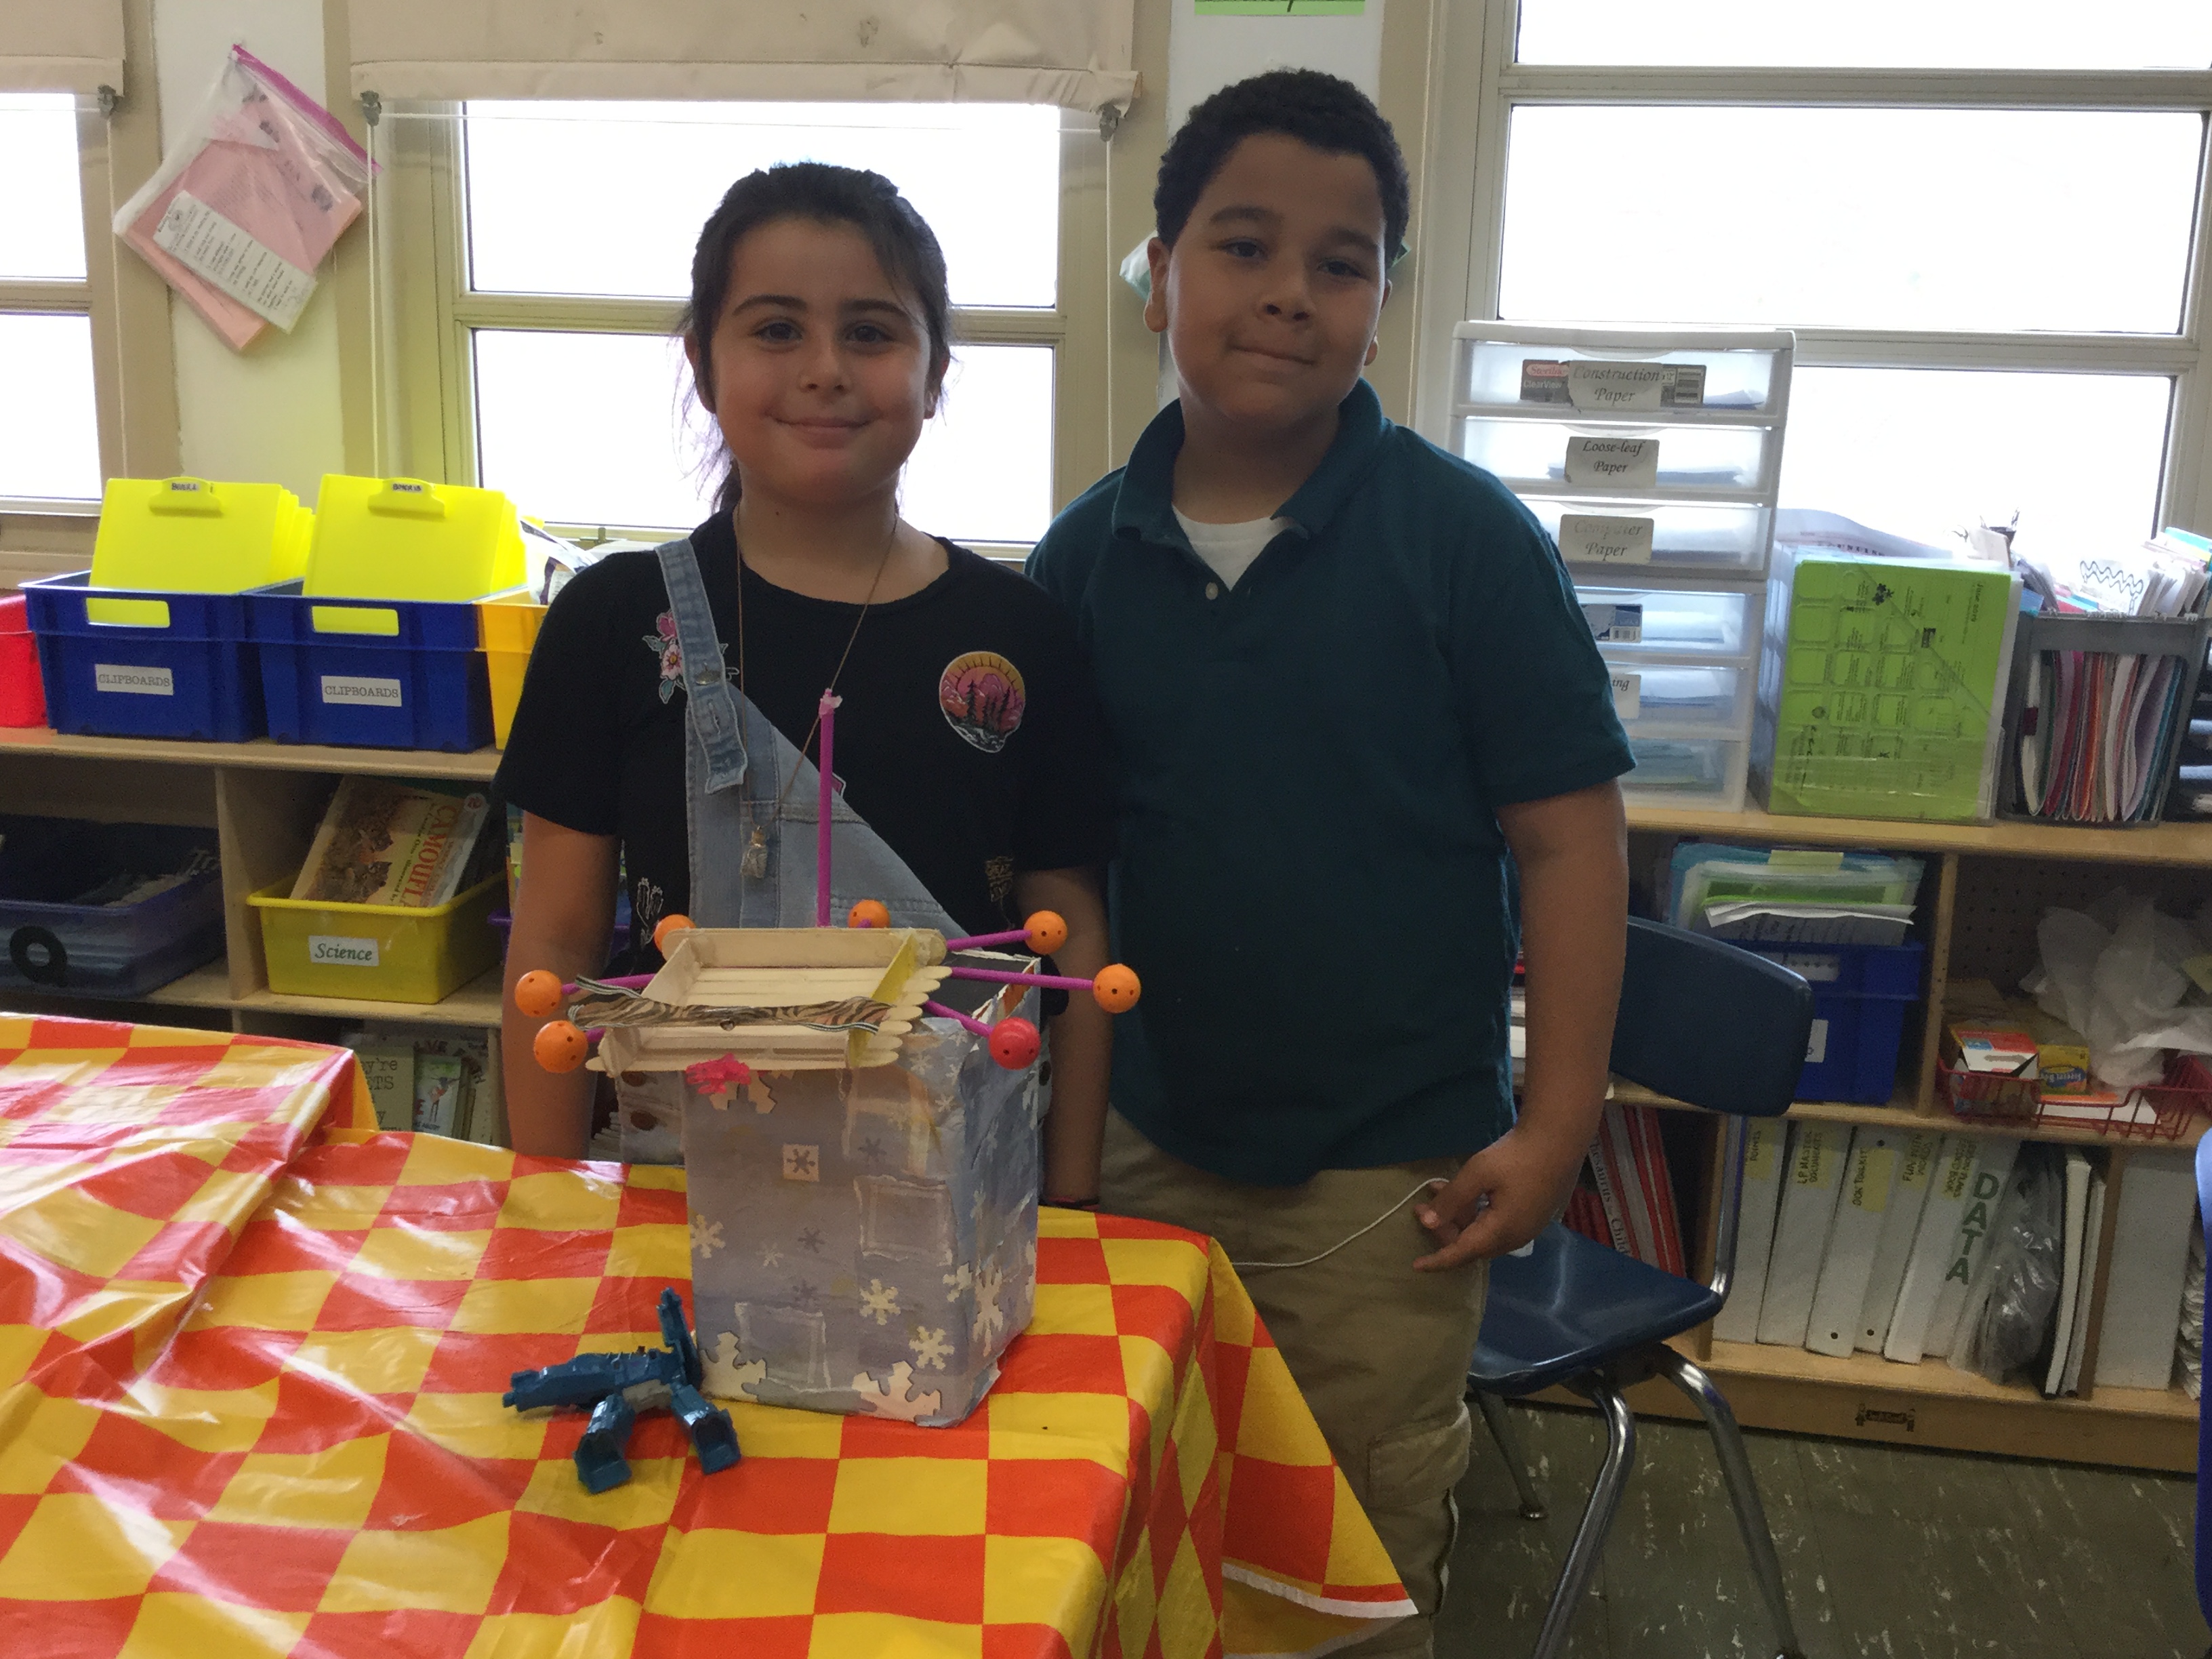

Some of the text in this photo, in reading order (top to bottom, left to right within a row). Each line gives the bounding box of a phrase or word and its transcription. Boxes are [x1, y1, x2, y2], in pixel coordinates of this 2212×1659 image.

[1573, 365, 1660, 385] Construction
[1594, 387, 1635, 407] Paper
[1582, 441, 1645, 457] Loose-leaf
[1594, 460, 1628, 476] Paper
[1586, 542, 1627, 561] Paper
[98, 674, 171, 687] CLIPBOARDS
[1613, 677, 1630, 691] ing
[325, 685, 398, 698] CLIPBOARDS
[315, 943, 373, 961] Science
[1944, 1171, 2000, 1286] DATA
